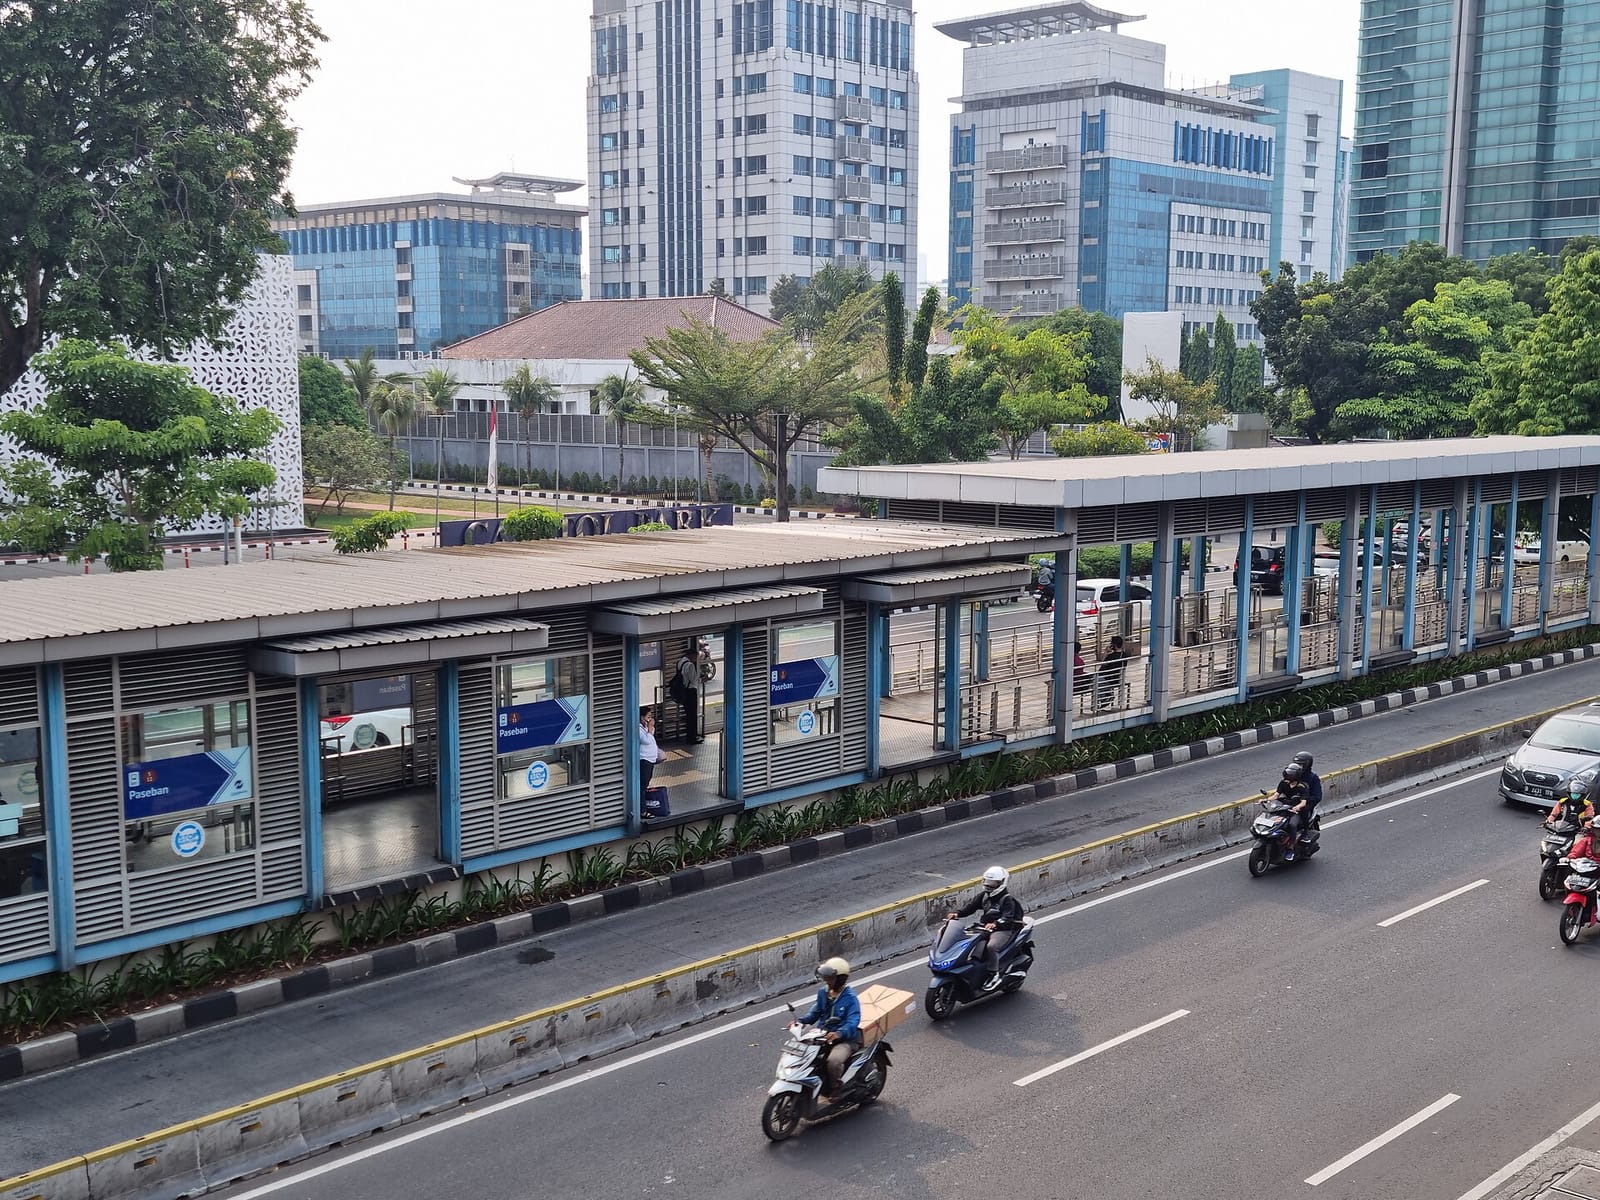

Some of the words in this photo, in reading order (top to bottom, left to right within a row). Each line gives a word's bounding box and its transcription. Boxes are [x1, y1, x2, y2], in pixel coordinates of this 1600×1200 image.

[771, 682, 794, 691] Paseban
[499, 727, 528, 738] Paseban
[129, 786, 169, 800] Paseban
